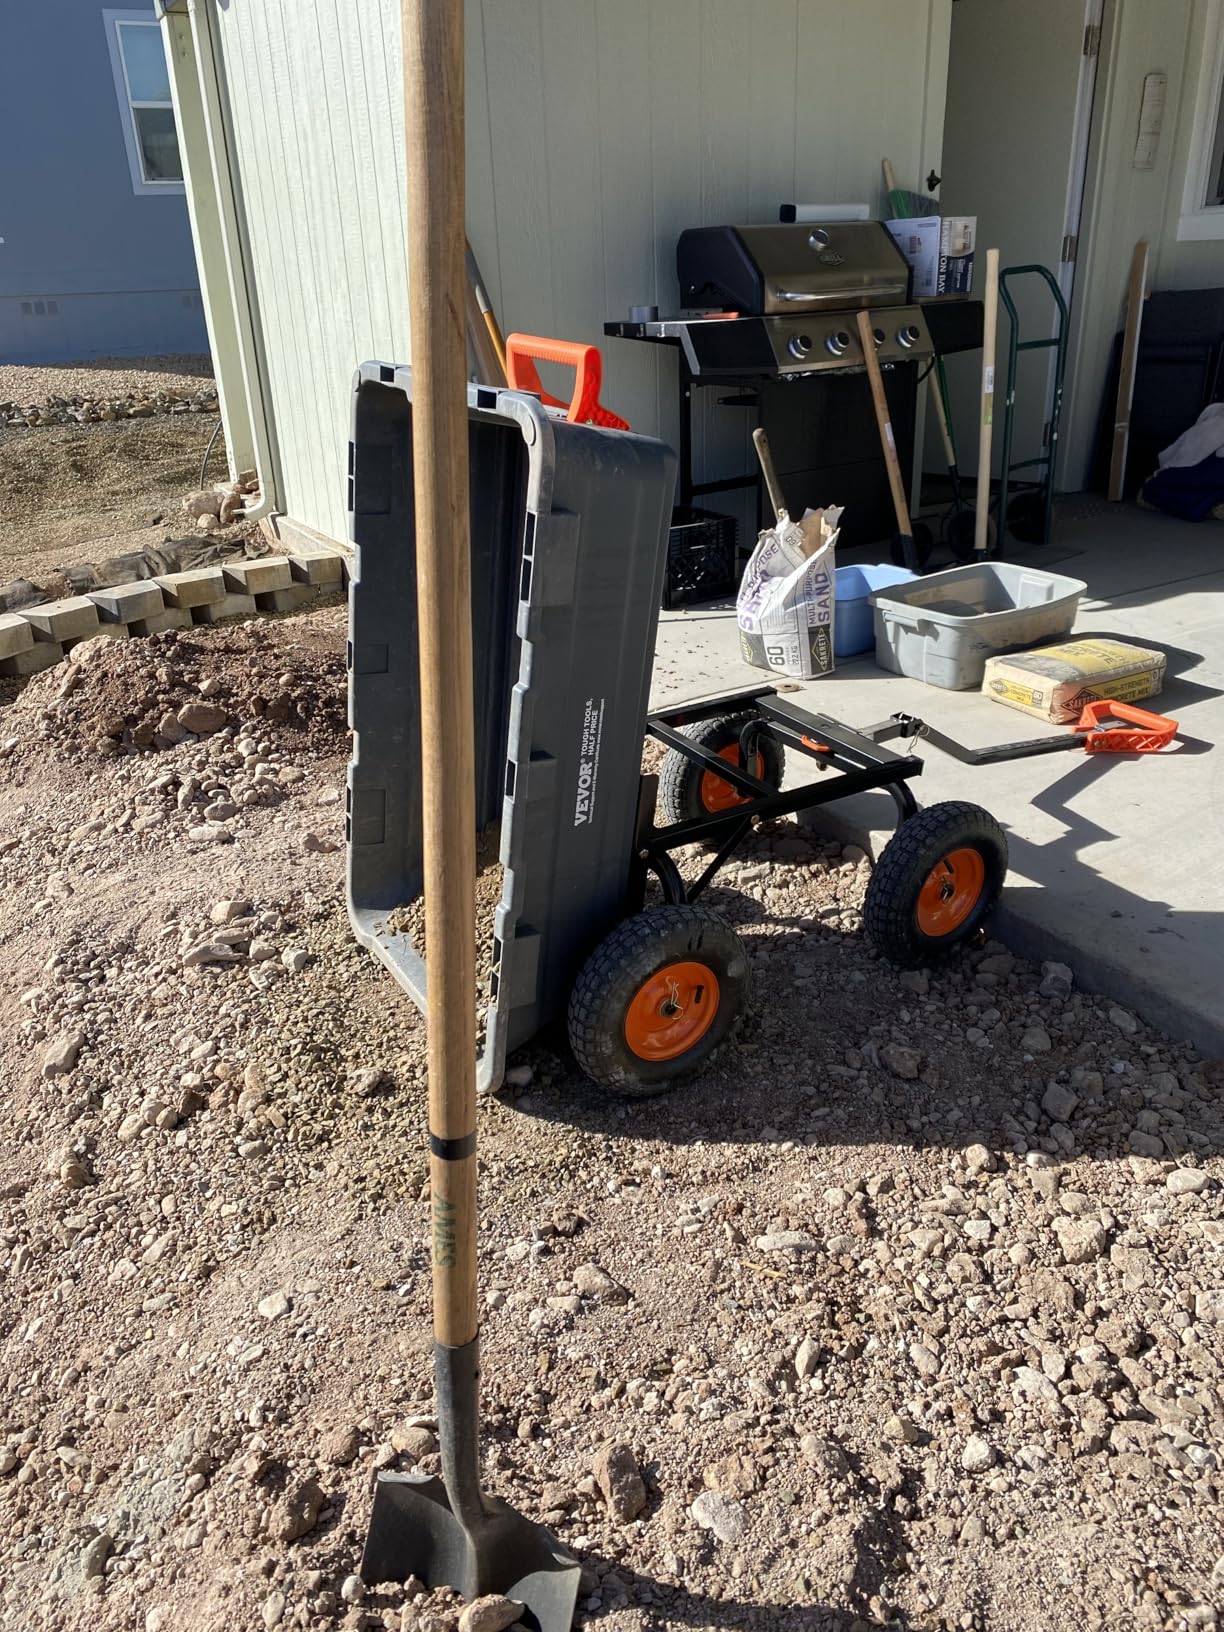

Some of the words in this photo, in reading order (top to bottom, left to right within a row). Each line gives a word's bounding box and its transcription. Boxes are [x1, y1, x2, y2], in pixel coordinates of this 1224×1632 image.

[940, 221, 951, 273] HAMPTON
[938, 274, 946, 293] BAY
[815, 572, 830, 622] SAND
[767, 646, 785, 666] 60
[817, 633, 828, 665] SAKRETE
[590, 709, 598, 734] PRICE
[581, 729, 590, 756] TOUGH
[588, 735, 596, 756] HALF
[574, 762, 592, 826] VEVOR
